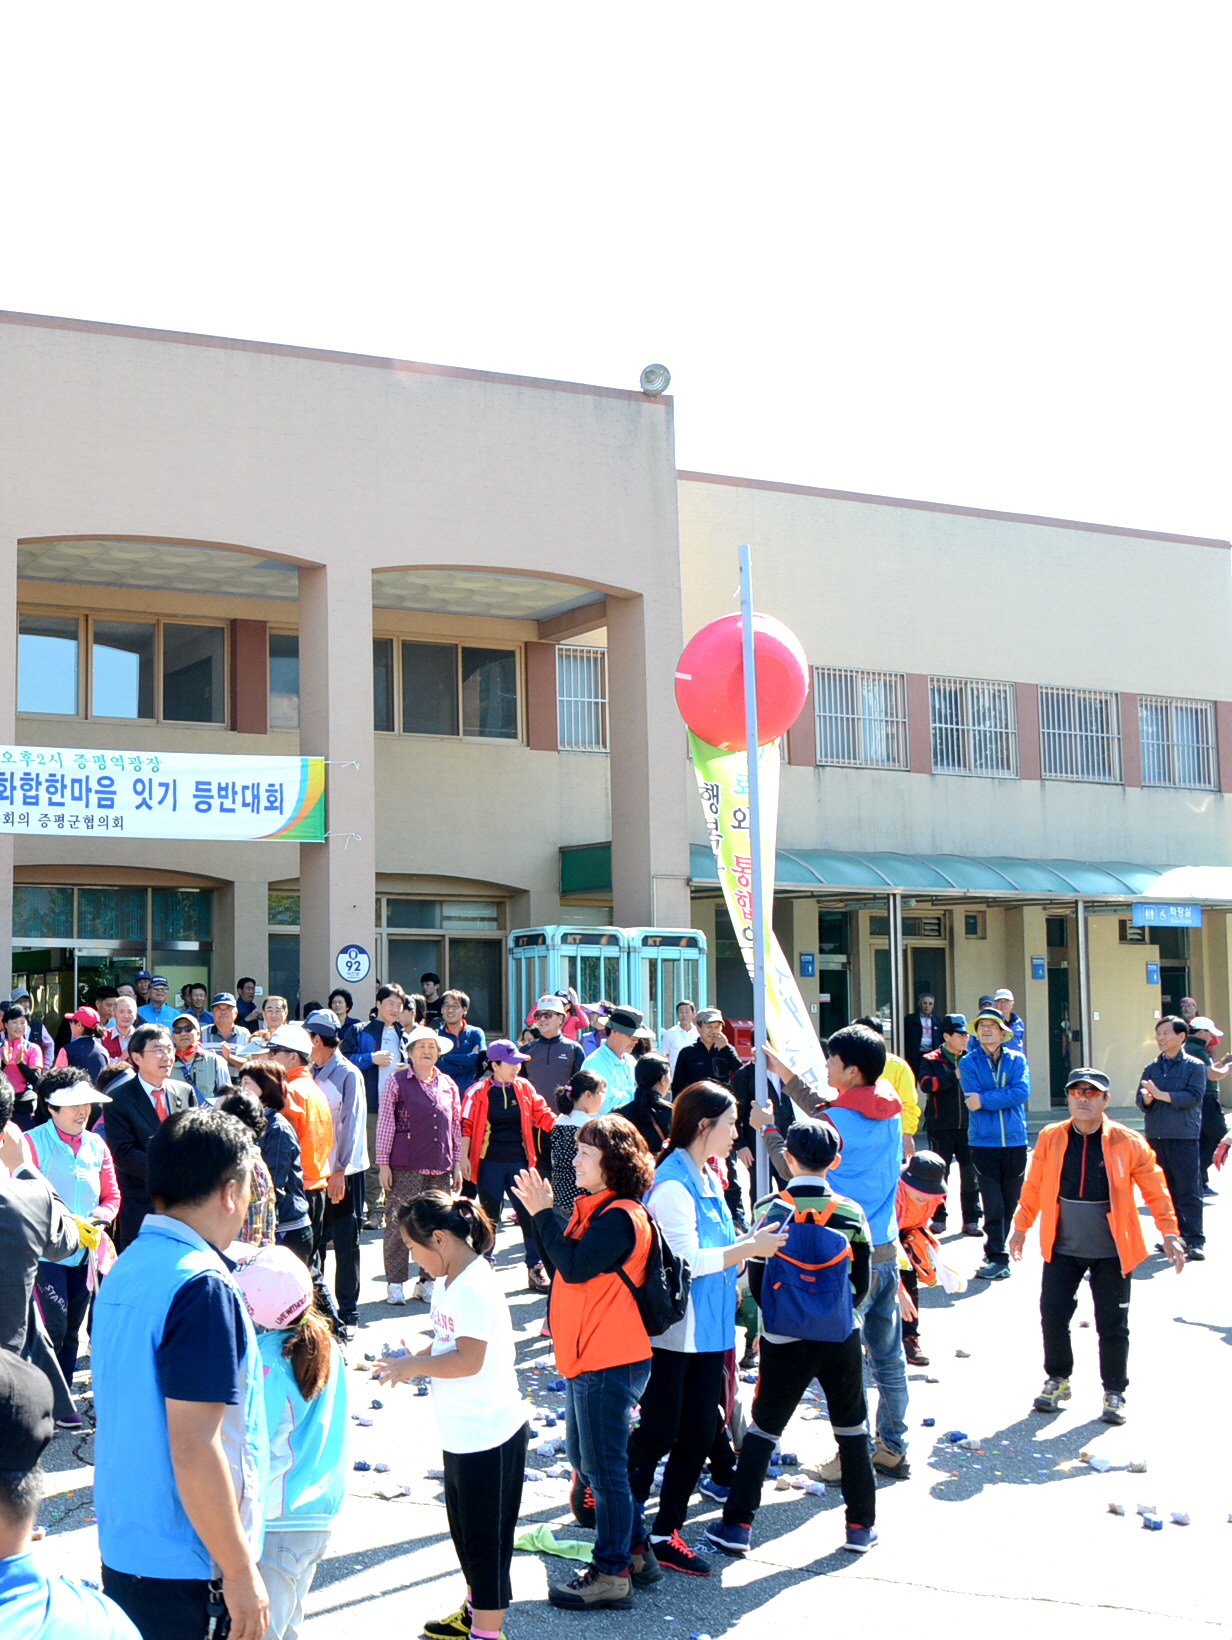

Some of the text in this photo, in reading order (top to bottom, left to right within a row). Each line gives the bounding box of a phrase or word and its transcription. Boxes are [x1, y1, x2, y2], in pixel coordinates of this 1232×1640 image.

[0, 750, 64, 769] 오후2시
[72, 753, 163, 774] 증평역광장
[132, 777, 178, 813] 잇기
[191, 780, 285, 816] 등반대회
[37, 812, 125, 832] 증평군협의회
[1169, 905, 1193, 918] 화장실
[567, 934, 583, 944] KT
[648, 937, 663, 946] KT
[345, 960, 362, 972] 92
